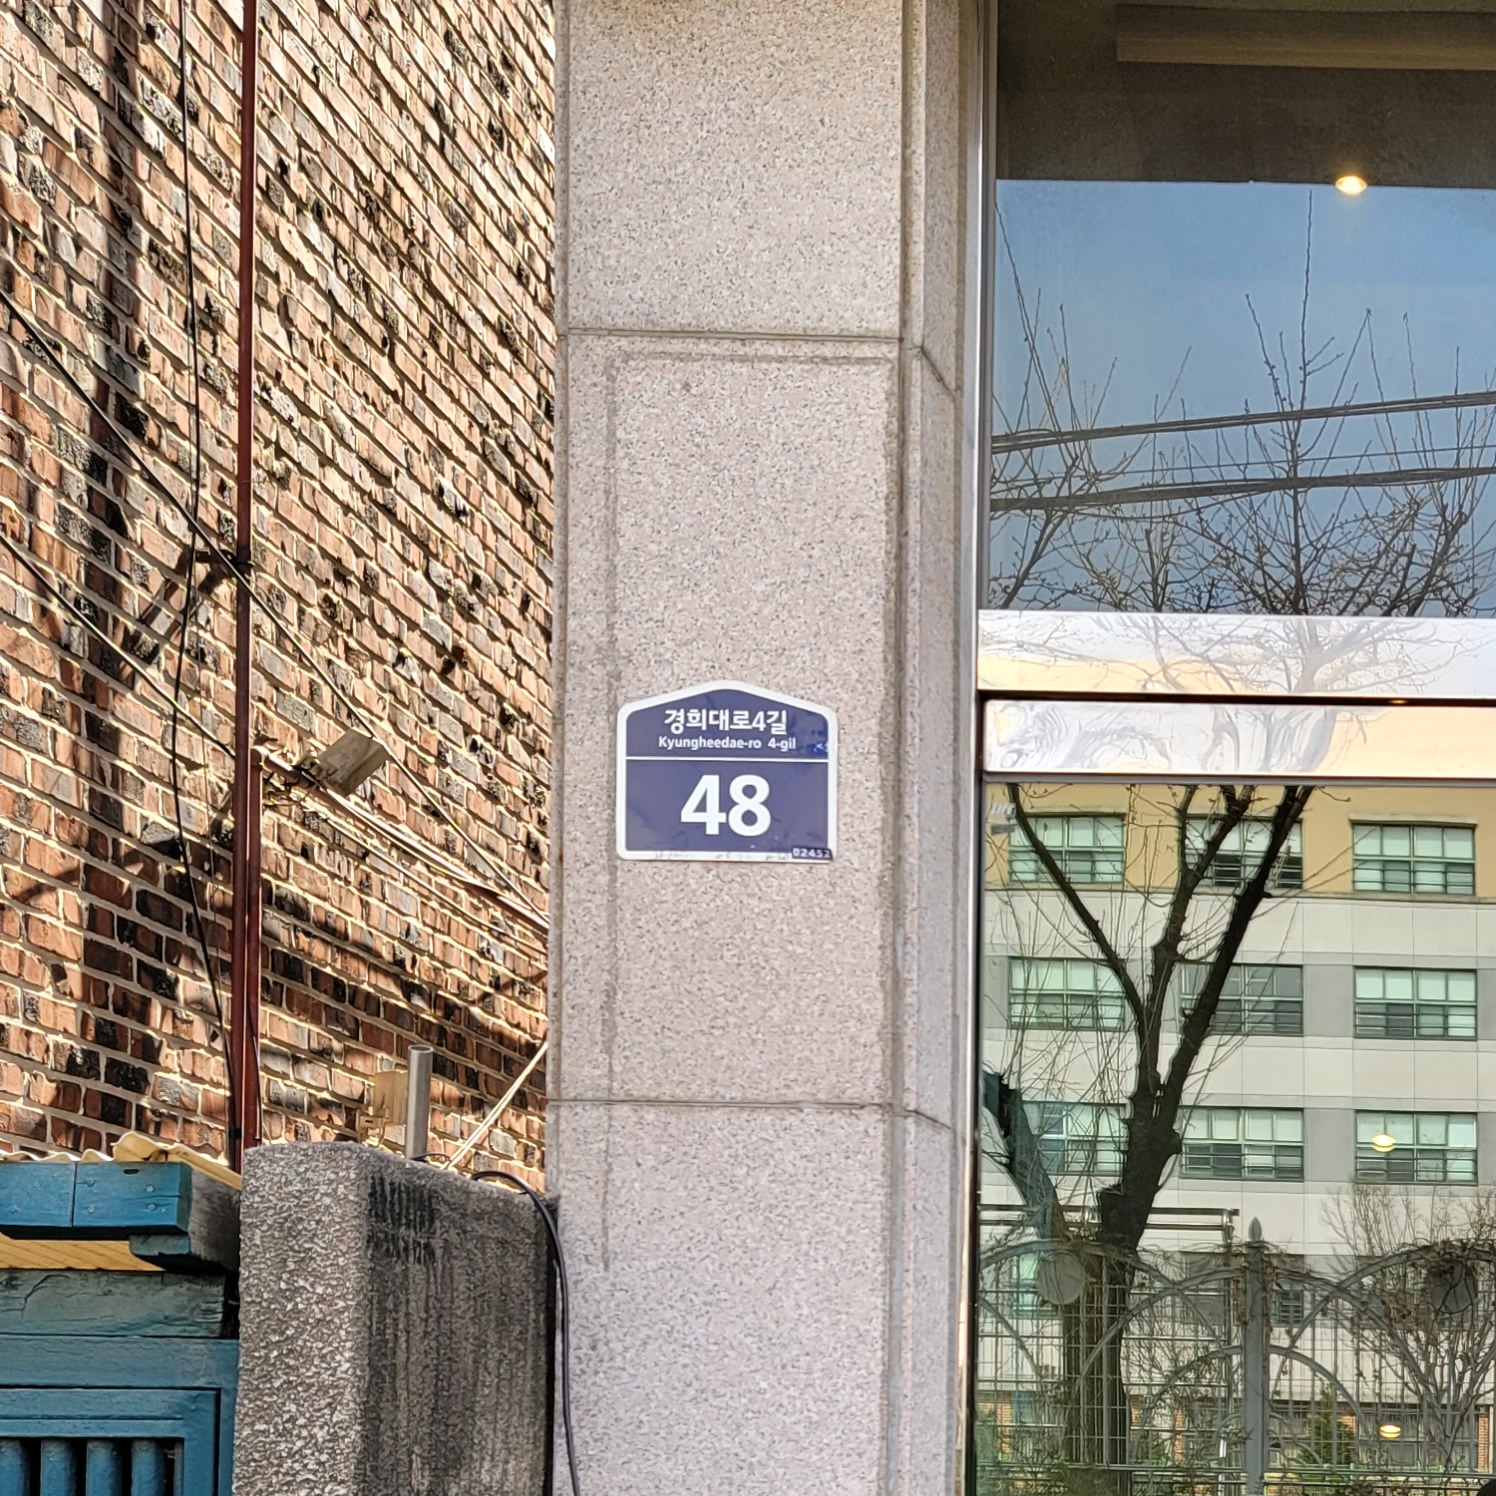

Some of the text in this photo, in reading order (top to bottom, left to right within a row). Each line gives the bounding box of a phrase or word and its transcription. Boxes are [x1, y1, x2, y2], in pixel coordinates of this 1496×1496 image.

[664, 709, 787, 735] 경희대로4길
[658, 736, 796, 752] Kyungheedae-ro 4-gil
[681, 774, 771, 836] 48
[793, 848, 831, 858] 02452
